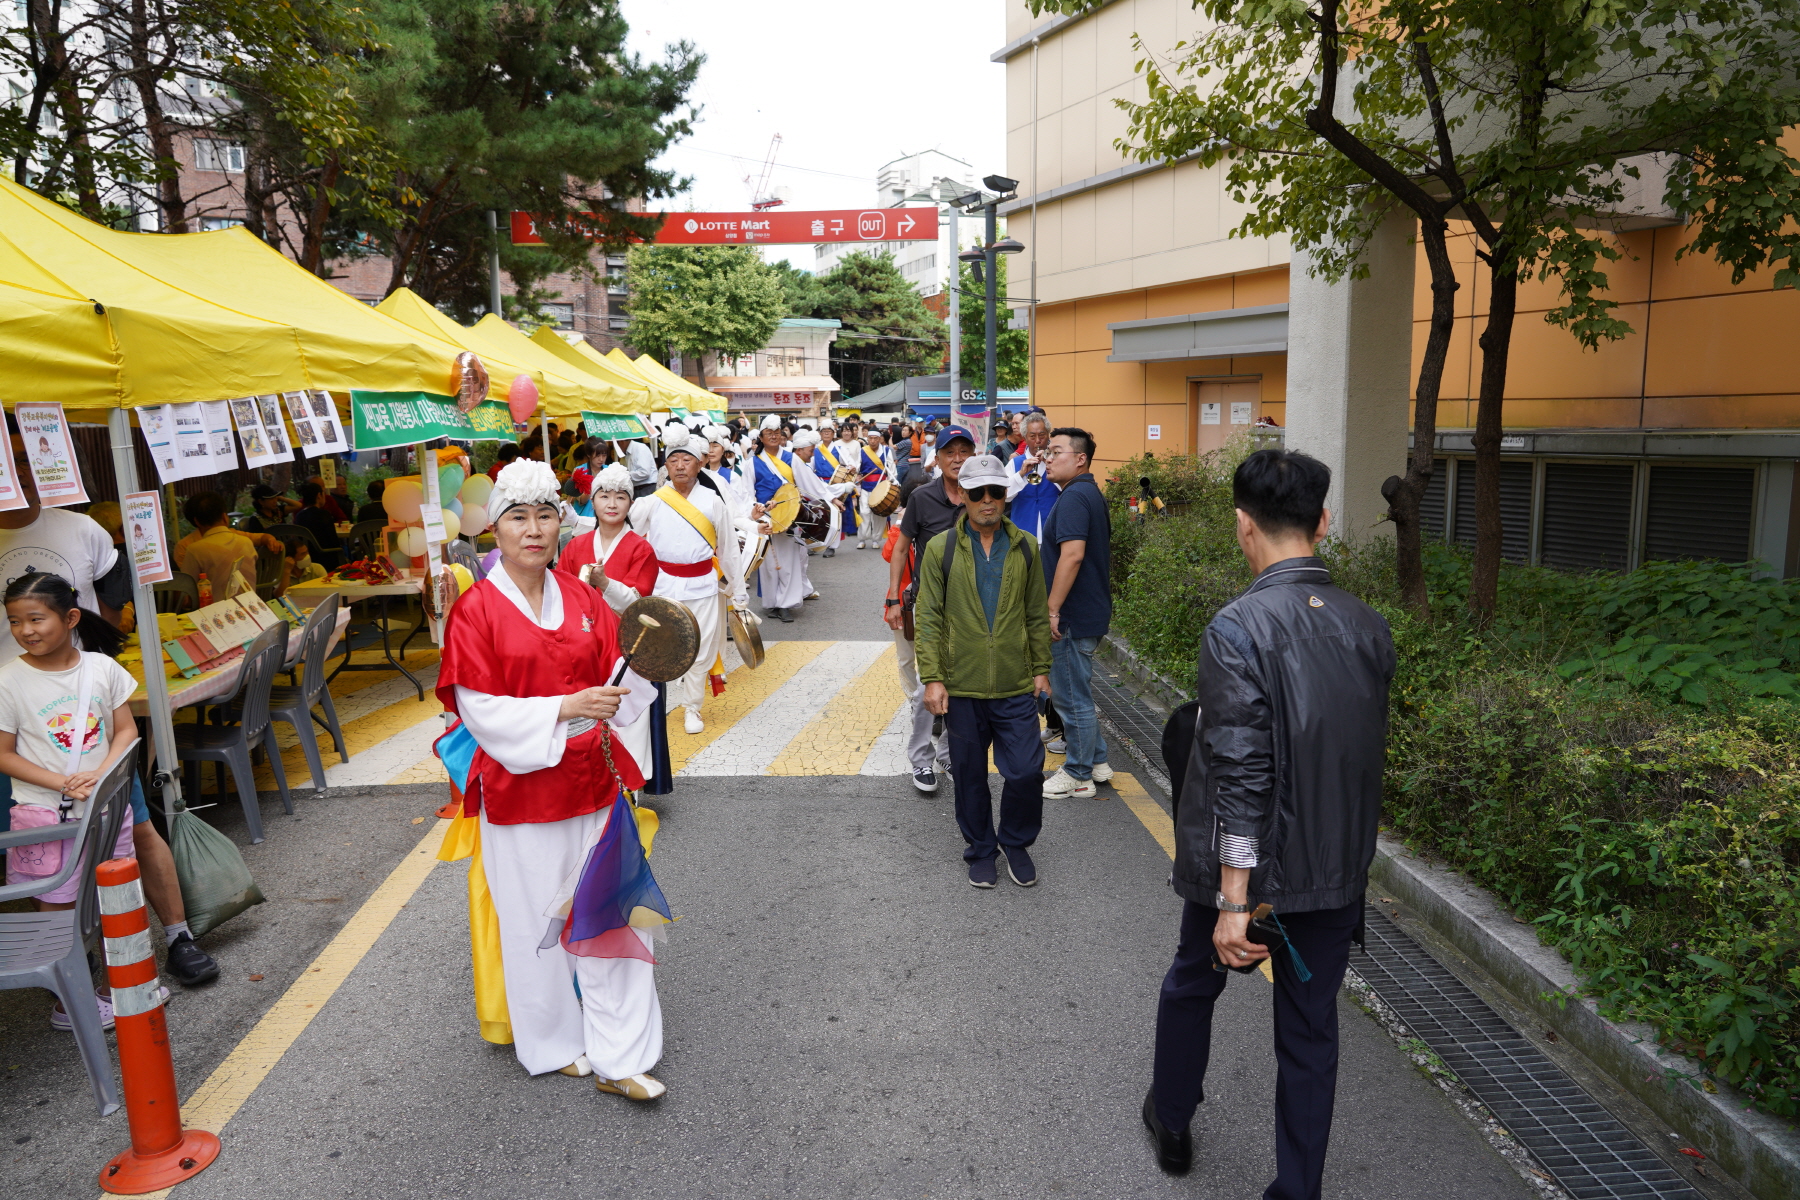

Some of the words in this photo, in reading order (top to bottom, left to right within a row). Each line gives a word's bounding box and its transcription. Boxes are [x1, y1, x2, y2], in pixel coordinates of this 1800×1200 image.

[700, 222, 737, 231] LOTTE
[741, 220, 770, 230] Mart
[811, 219, 844, 236] 출구
[861, 220, 881, 231] OUT
[0, 551, 27, 576] ORTLAND
[37, 694, 78, 717] TROPICAL
[91, 695, 103, 705] ICE
